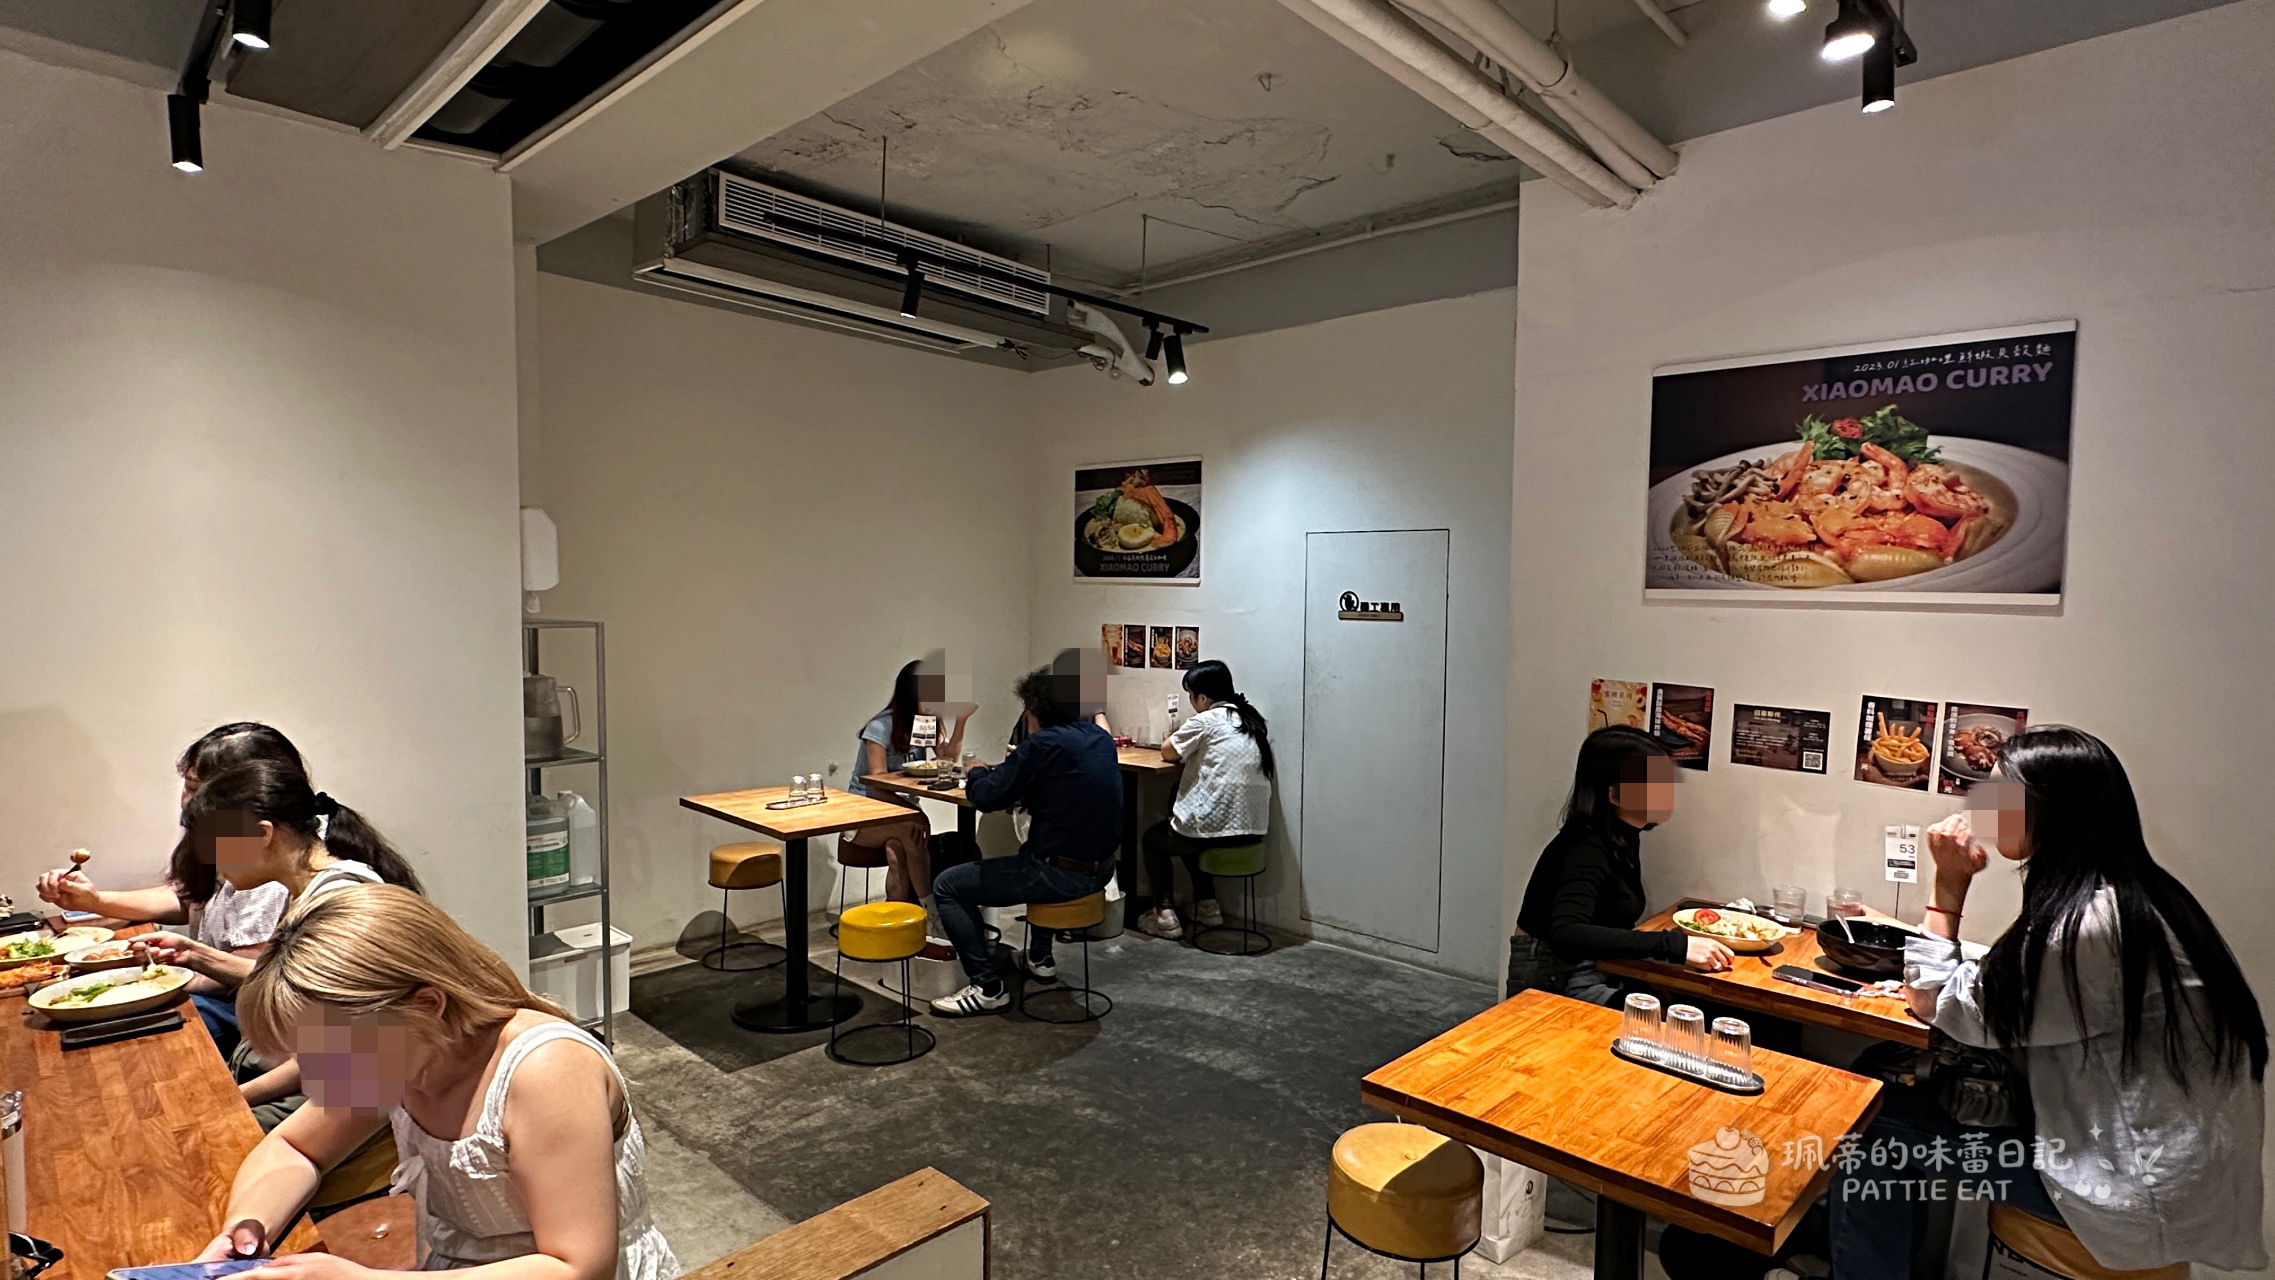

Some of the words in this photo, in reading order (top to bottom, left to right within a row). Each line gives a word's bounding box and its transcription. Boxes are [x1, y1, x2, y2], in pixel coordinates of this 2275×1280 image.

[1801, 372, 1939, 403] XIAOMAO
[1945, 361, 2054, 390] CURRY
[1099, 562, 1140, 573] XIAOMAO
[1140, 562, 1171, 573] CURRY
[1899, 843, 1916, 855] 53
